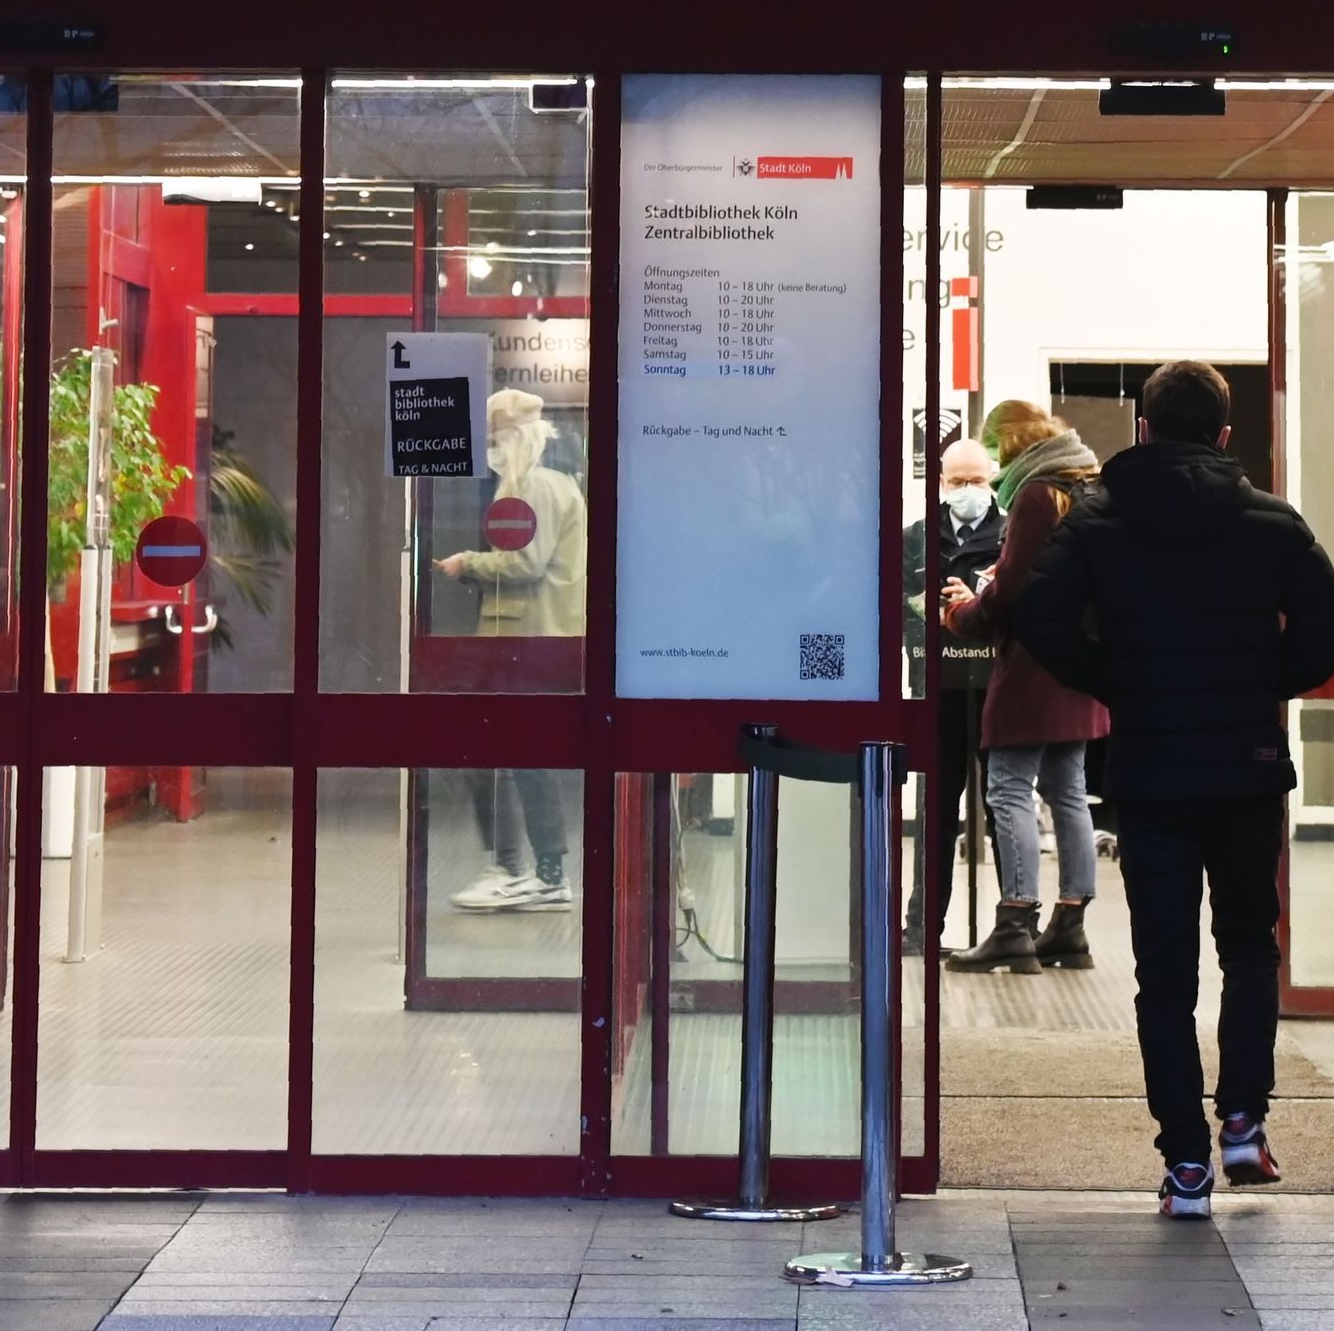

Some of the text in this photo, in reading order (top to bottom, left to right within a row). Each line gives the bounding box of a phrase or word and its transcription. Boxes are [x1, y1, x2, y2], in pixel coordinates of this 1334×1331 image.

[759, 163, 812, 174] Stadt Köln
[644, 204, 798, 220] Stadtbibliothek Köln
[644, 224, 775, 240] Zentralbibliothek
[644, 265, 720, 280] Öffnungszeiten
[643, 281, 683, 293] Montag
[717, 281, 730, 292] 10
[741, 281, 754, 292] 18
[756, 281, 774, 292] Uhr
[777, 284, 804, 294] (keine
[805, 283, 847, 294] Beratung)
[643, 294, 688, 307] Dienstag
[717, 295, 730, 305] 10
[741, 295, 754, 305] 20
[756, 294, 774, 305] Uhr
[643, 308, 692, 319] Mittwoch
[717, 309, 730, 319] 10
[741, 309, 754, 319] 18
[756, 308, 774, 319] Uhr
[643, 322, 702, 334] Donnerstag
[717, 322, 730, 332] 10
[741, 322, 754, 332] 20
[756, 321, 774, 332] Uhr
[489, 332, 590, 351] undens
[643, 335, 678, 348] Freitag
[717, 336, 730, 346] 10
[741, 336, 754, 346] 18
[756, 335, 774, 346] Uhr
[643, 349, 687, 361] Samstag
[717, 349, 730, 360] 10
[741, 349, 754, 360] 15
[756, 349, 774, 360] Uhr
[493, 362, 588, 383] ernleihe
[643, 364, 687, 377] Sonntag
[718, 365, 730, 375] 13
[742, 365, 755, 375] 18
[756, 364, 775, 375] Uhr
[395, 385, 425, 398] stadt
[395, 395, 455, 410] bibliothek
[395, 409, 420, 421] köln
[642, 425, 692, 438] Rückgabe
[702, 425, 720, 438] Tag
[722, 425, 742, 436] und
[744, 426, 773, 437] Nacht
[397, 437, 467, 453] RÜCKGABE
[398, 461, 468, 475] TAG & NACHT
[639, 647, 729, 658] www.stbib-koeln.de
[942, 646, 989, 659] Abstand
